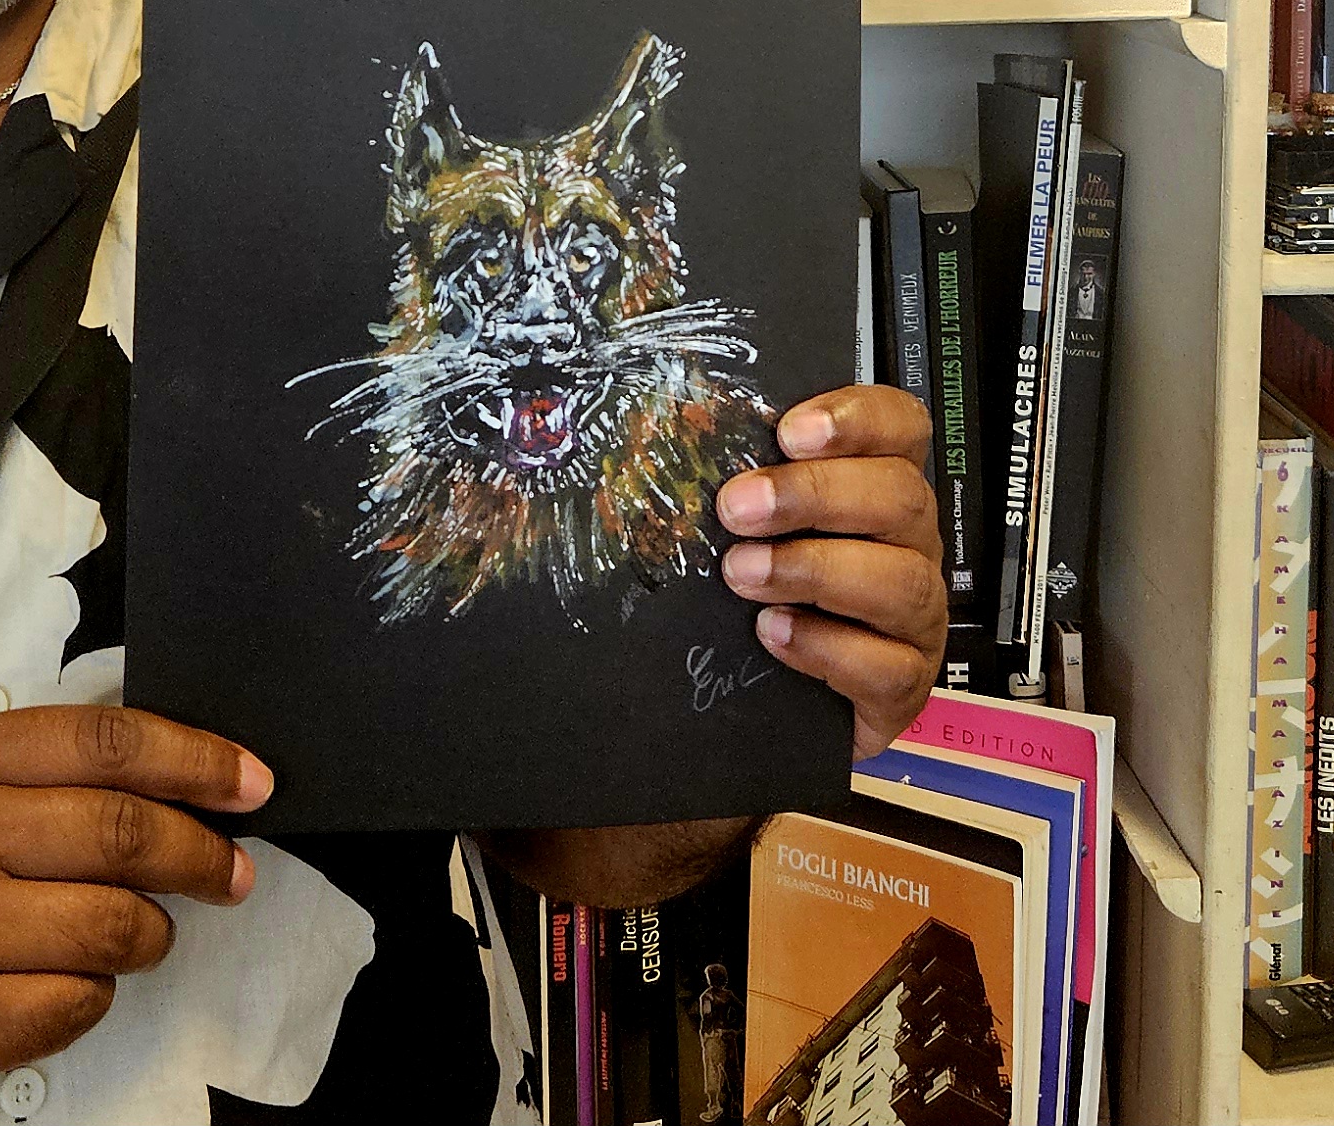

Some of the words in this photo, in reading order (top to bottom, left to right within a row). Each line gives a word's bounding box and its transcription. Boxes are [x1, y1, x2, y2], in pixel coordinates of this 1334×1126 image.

[1038, 119, 1055, 173] PEUR
[1033, 182, 1050, 206] LA
[1027, 214, 1047, 286] FILMER
[901, 273, 919, 331] VENIMEUX
[938, 250, 960, 332] L'HORREUR
[942, 336, 960, 356] DE
[943, 361, 965, 444] ENTRAILLES
[947, 449, 966, 474] LES
[1005, 345, 1037, 528] SIMULACRES
[952, 479, 963, 517] Charnage
[954, 532, 964, 564] Violaine
[942, 724, 1055, 763] EDITION
[776, 844, 837, 882] FOGLI
[842, 862, 931, 908] BIANCHI
[553, 913, 570, 981] Romero
